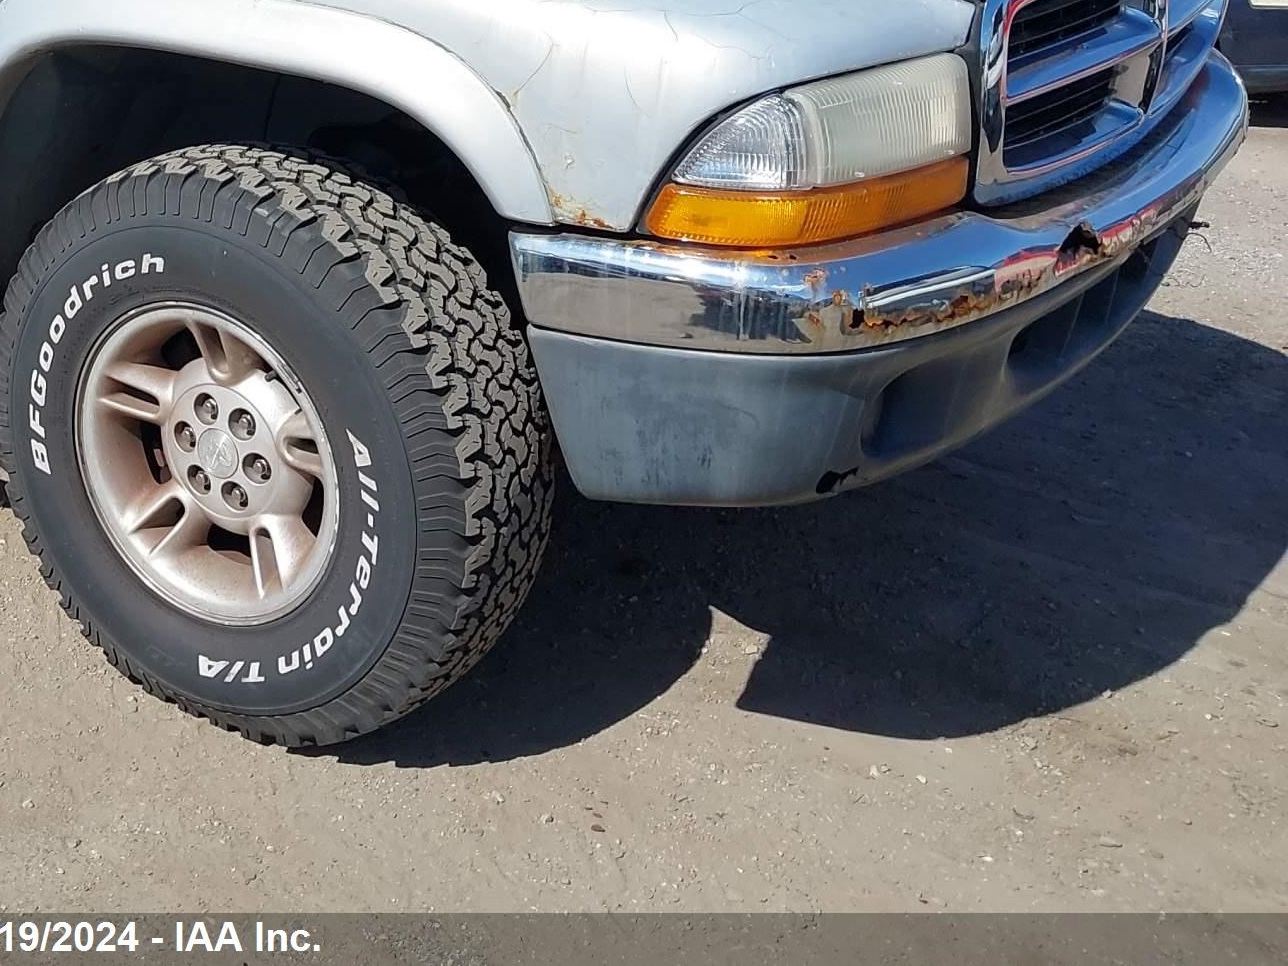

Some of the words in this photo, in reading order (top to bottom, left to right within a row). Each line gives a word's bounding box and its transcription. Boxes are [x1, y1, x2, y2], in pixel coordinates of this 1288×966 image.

[28, 252, 166, 476] BFGoodrich
[278, 427, 380, 675] All-Terrain
[198, 654, 265, 683] T/A
